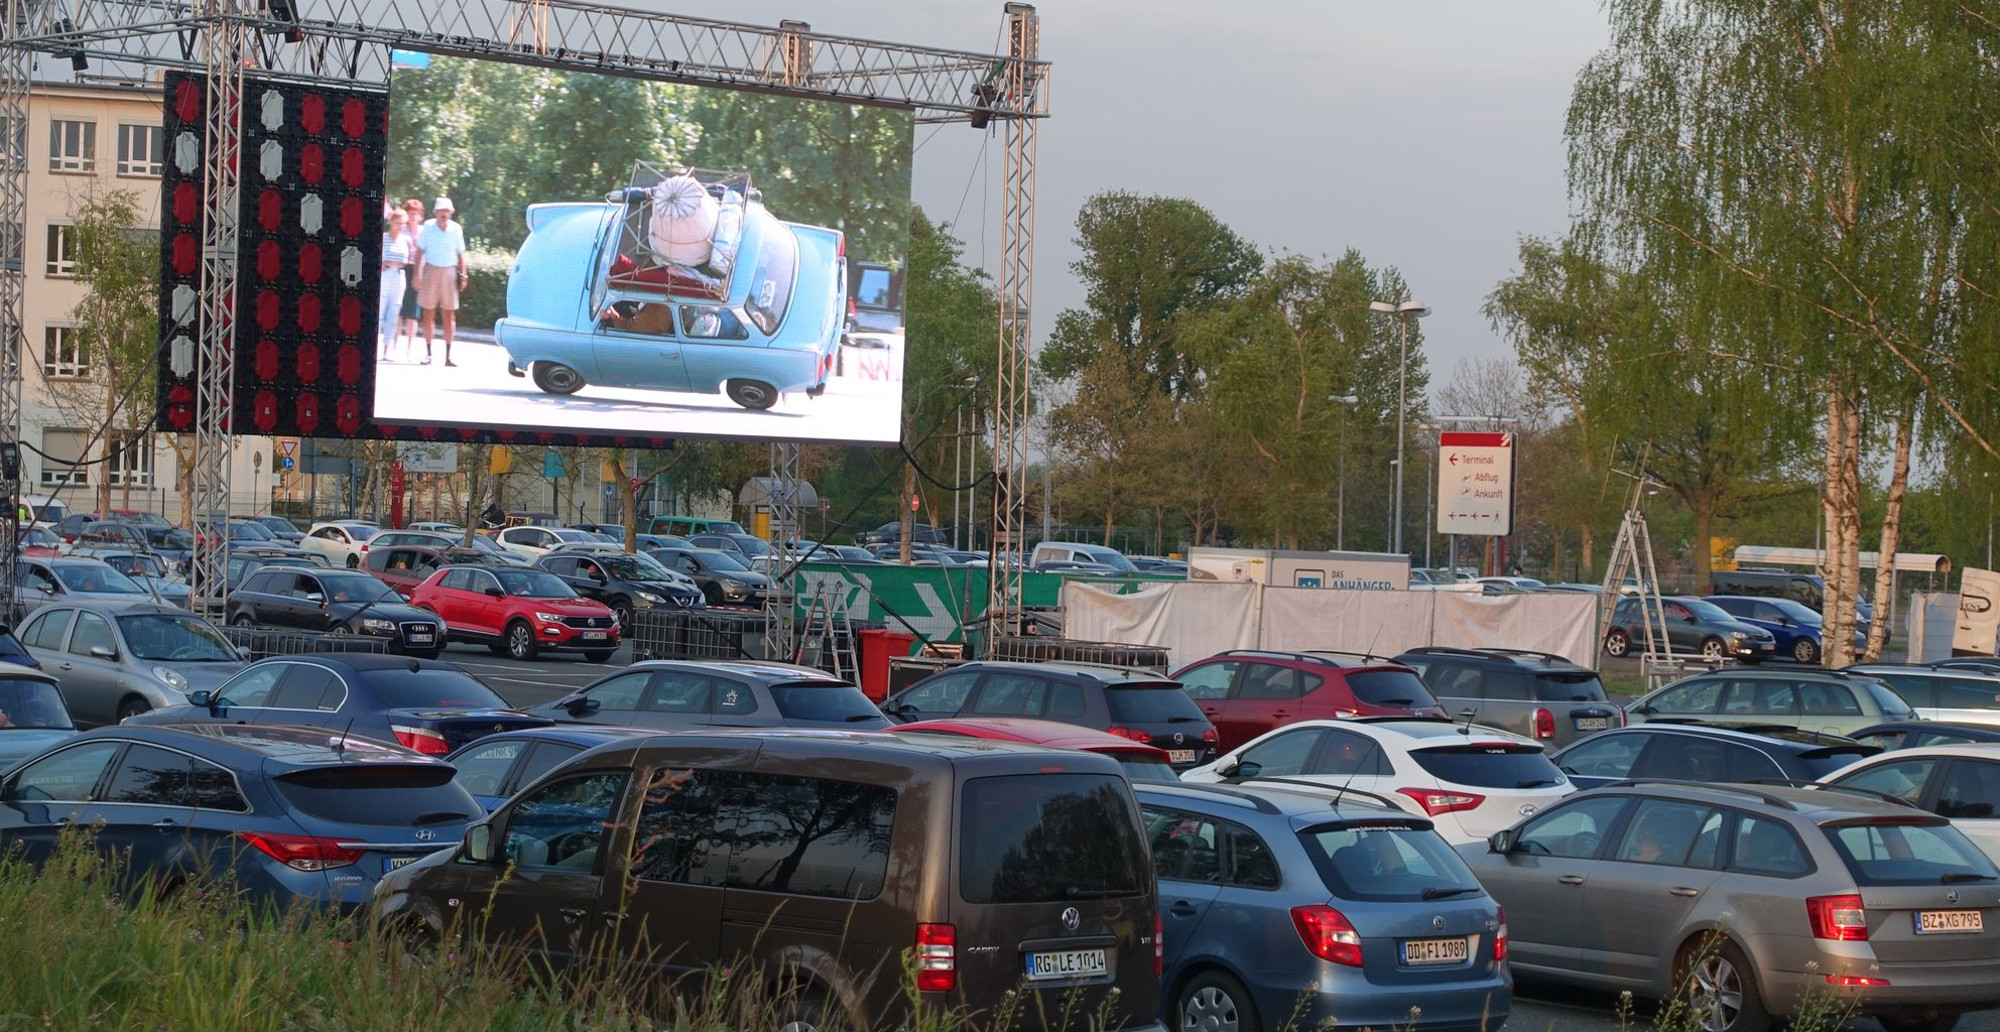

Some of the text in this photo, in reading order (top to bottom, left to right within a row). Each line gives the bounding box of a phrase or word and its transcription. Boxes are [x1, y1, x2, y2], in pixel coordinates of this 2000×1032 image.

[1462, 454, 1494, 464] Terminal
[1475, 472, 1499, 484] Abflug
[1475, 489, 1503, 499] Ankunft
[1331, 570, 1344, 579] DAS
[1922, 912, 1981, 928] BZ XG 795
[1407, 941, 1466, 960] DD FI 1989
[1034, 951, 1104, 973] RG LE 1014
